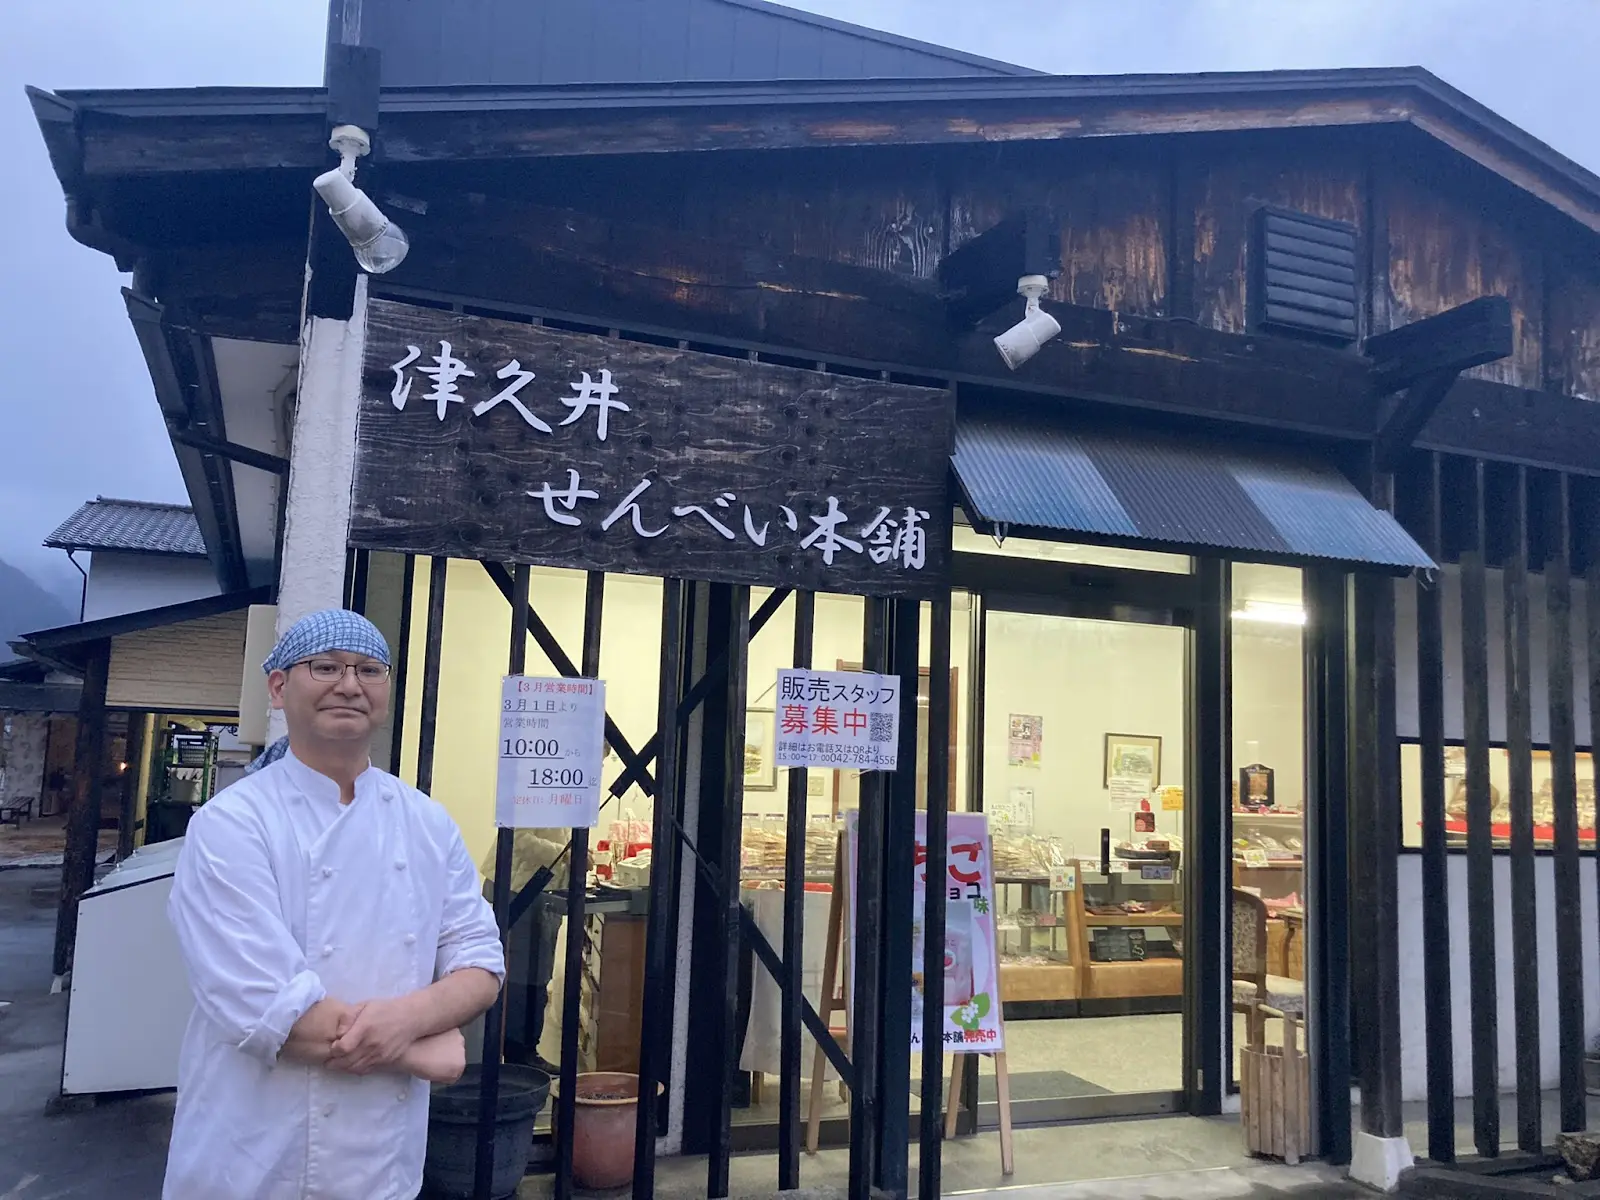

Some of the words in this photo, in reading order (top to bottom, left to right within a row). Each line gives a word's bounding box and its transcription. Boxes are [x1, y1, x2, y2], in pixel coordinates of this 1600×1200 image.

[391, 340, 630, 441] 津久井
[527, 469, 930, 570] せんべい本舗
[781, 676, 895, 704] 販売スタッフ
[503, 718, 549, 729] 営業時間
[781, 704, 867, 737] 募集中
[503, 739, 559, 756] 10:00
[778, 741, 880, 754] 詳細はお電話又はQRより
[530, 768, 584, 786] 18:00
